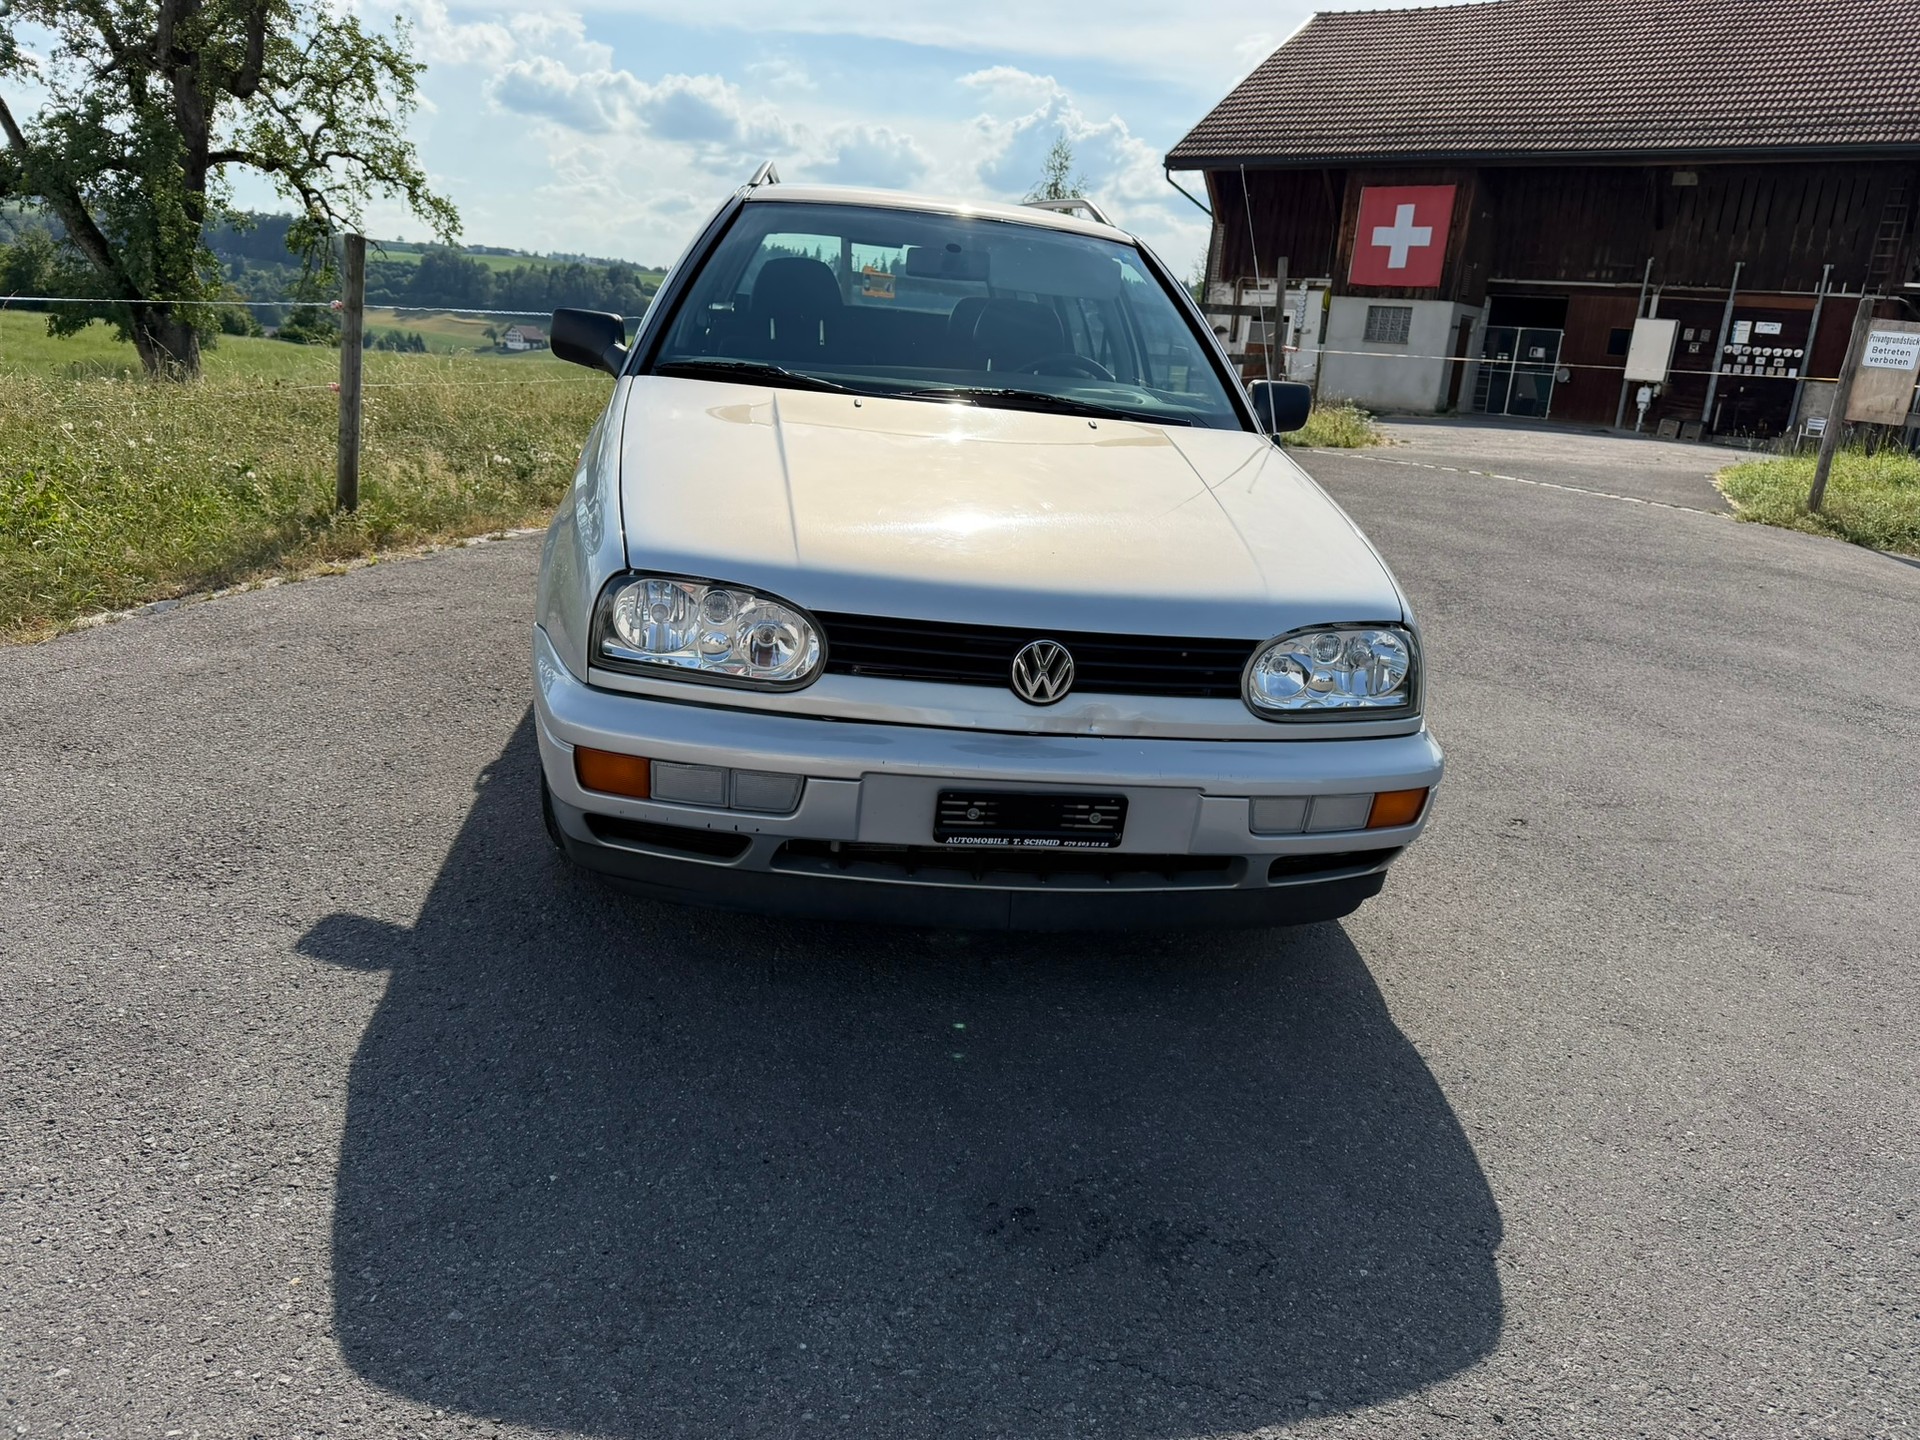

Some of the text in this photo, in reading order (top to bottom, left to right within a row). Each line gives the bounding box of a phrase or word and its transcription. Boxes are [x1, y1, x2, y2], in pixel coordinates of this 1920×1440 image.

[1869, 333, 1920, 346] Privatgrundstück
[1872, 346, 1911, 356] Betreten
[1870, 357, 1909, 366] verboten
[945, 836, 1009, 845] AUTOMOBILE
[1023, 838, 1060, 847] SCHMID
